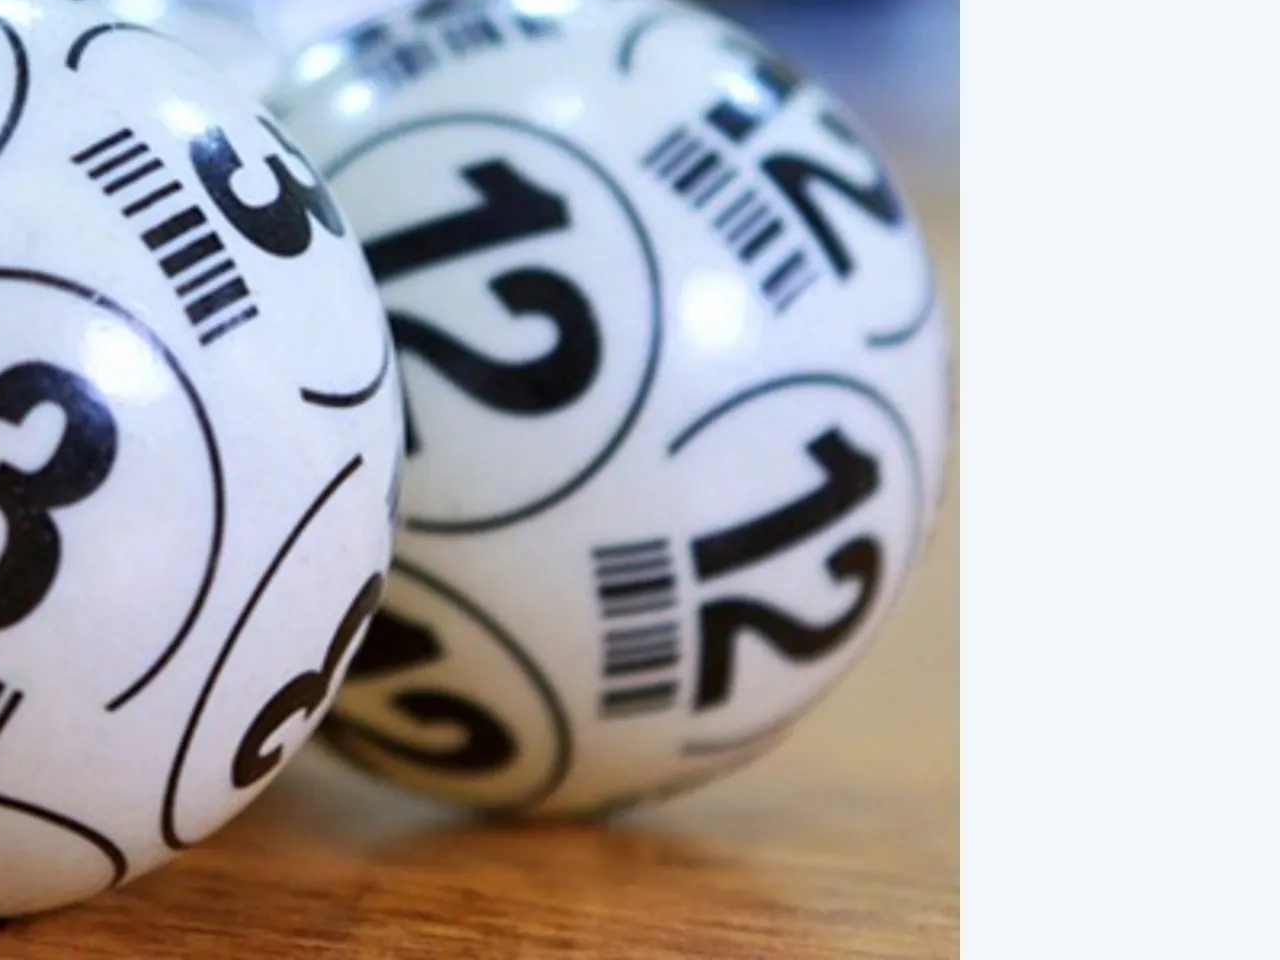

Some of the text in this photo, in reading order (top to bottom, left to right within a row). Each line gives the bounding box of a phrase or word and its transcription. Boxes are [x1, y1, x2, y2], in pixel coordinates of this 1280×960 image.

[189, 115, 345, 260] 3
[360, 157, 603, 460] 12
[689, 423, 883, 715] 12
